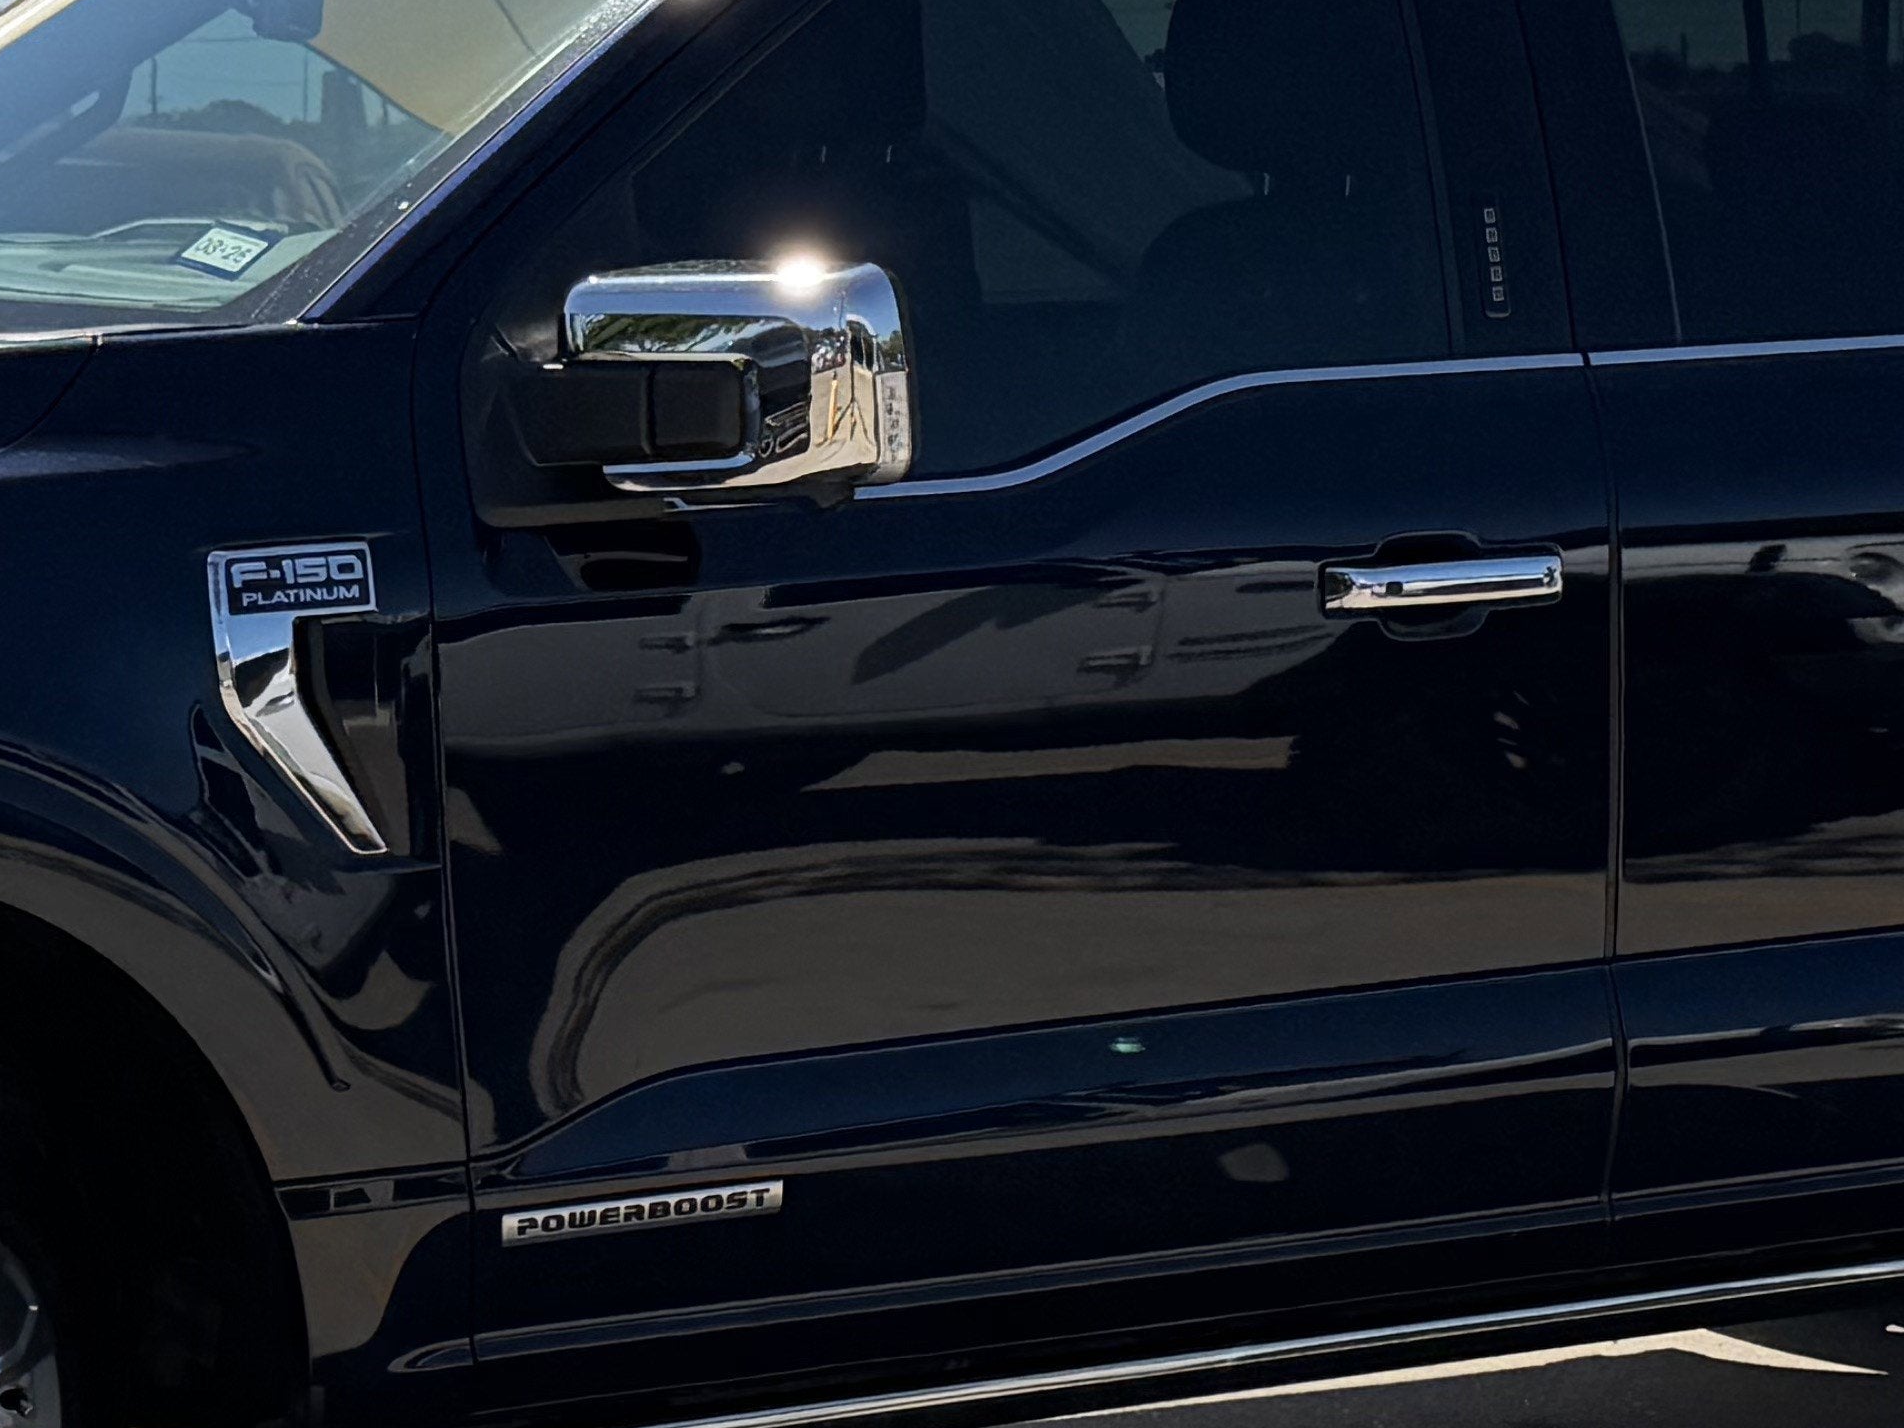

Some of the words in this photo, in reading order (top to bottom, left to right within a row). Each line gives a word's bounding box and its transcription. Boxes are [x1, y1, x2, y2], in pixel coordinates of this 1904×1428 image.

[230, 554, 364, 588] F-150
[242, 584, 360, 607] PLATINUM
[517, 1188, 770, 1236] POWERBOOST
